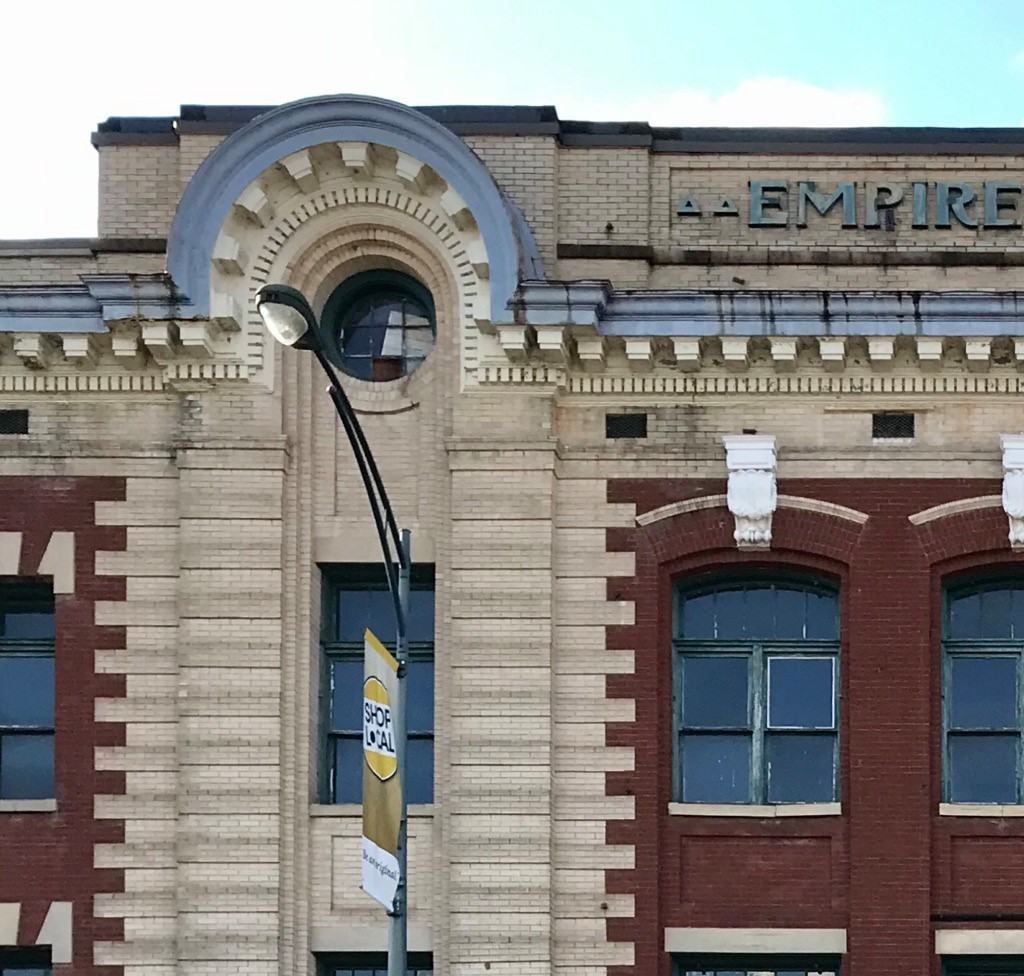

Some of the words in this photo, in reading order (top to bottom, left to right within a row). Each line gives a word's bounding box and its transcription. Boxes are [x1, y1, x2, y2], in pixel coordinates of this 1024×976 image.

[748, 180, 1022, 229] EMPIRE
[365, 702, 391, 729] SHOP
[365, 725, 395, 753] LOCAL
